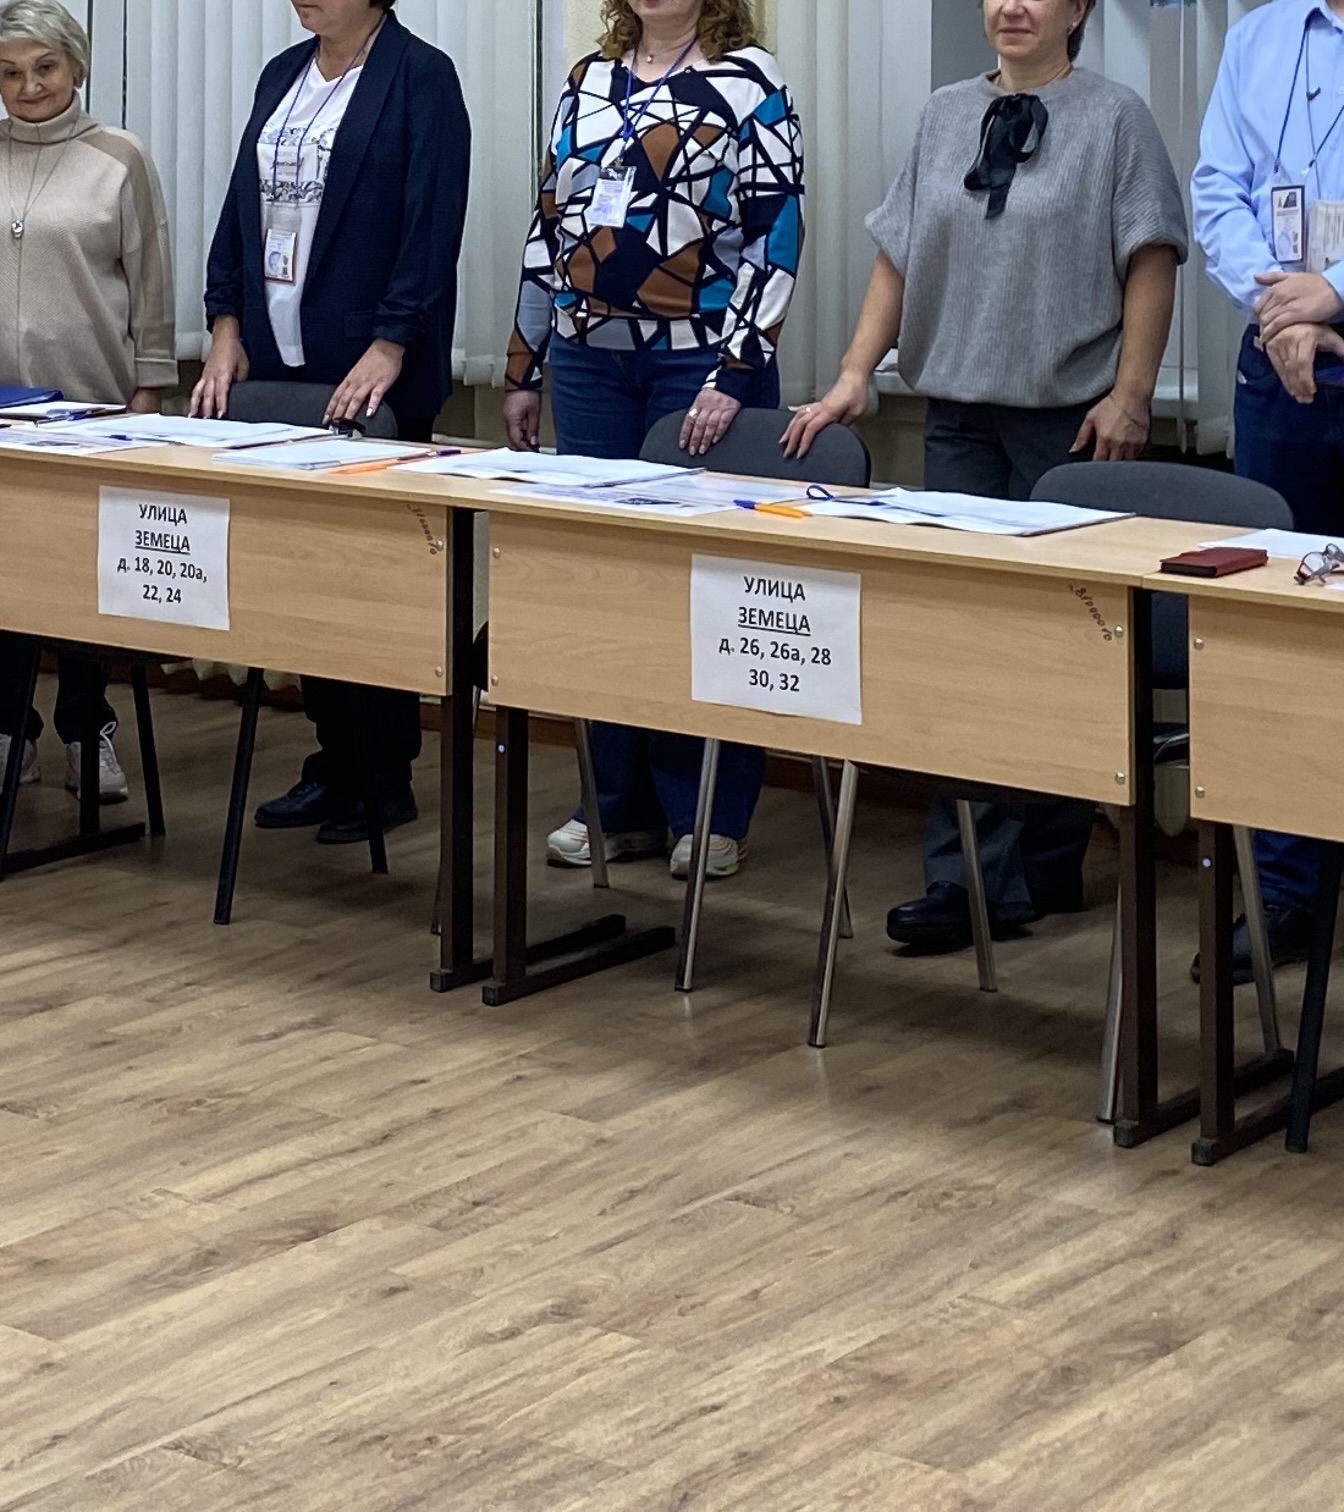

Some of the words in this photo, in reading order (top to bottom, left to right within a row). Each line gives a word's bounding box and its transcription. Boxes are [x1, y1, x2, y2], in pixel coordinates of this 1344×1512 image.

[139, 504, 188, 527] УЛИЦА
[135, 530, 191, 555] ЗЕМЕЦА
[117, 558, 131, 573] д.
[135, 557, 154, 576] 18,
[157, 560, 177, 579] 20,
[180, 563, 208, 583] 20а,
[142, 584, 162, 604] 22,
[166, 587, 182, 604] 24
[743, 576, 806, 603] УЛИЦА
[737, 606, 811, 636] ЗЕМЕЦА
[718, 638, 735, 656] д.
[740, 637, 765, 660] 26,
[770, 641, 806, 666] 26а,
[810, 647, 832, 666] 28
[748, 669, 774, 692] 30,
[779, 674, 800, 692] 32
